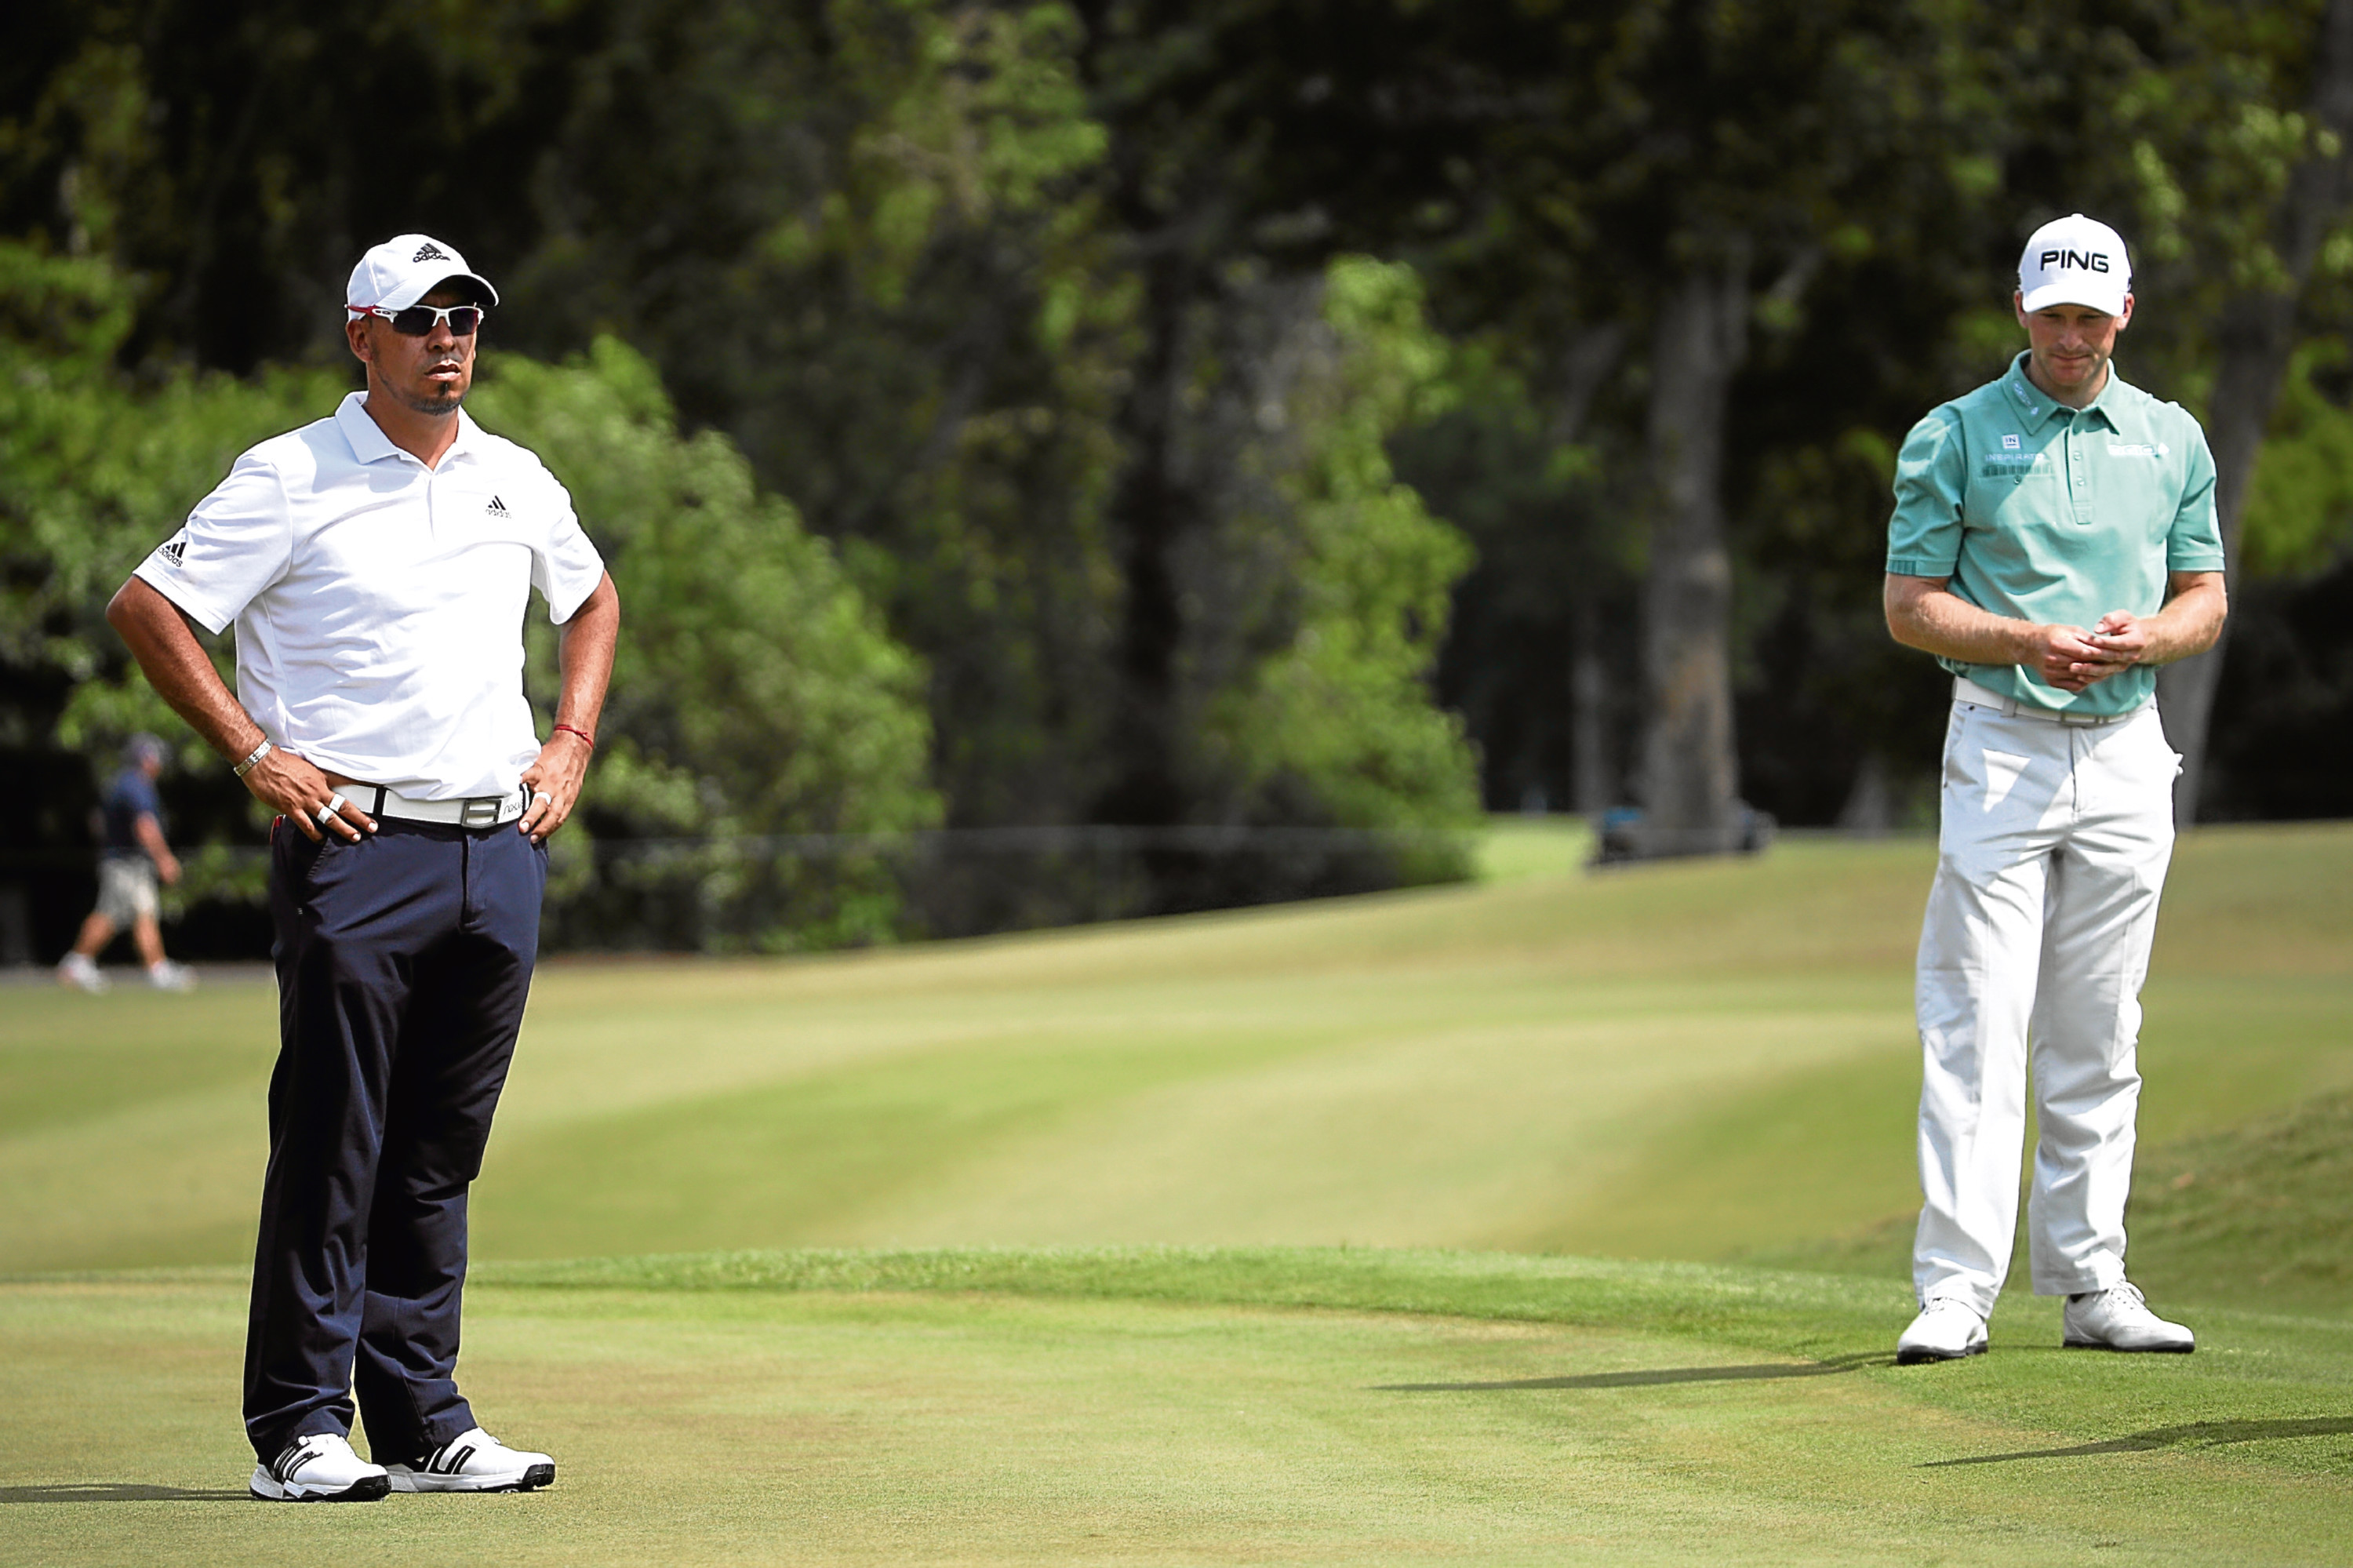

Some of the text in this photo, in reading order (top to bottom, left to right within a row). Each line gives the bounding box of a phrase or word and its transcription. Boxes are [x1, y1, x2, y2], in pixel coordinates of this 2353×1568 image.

[413, 251, 451, 263] adidas
[2040, 249, 2109, 273] PING
[157, 548, 183, 567] adidas
